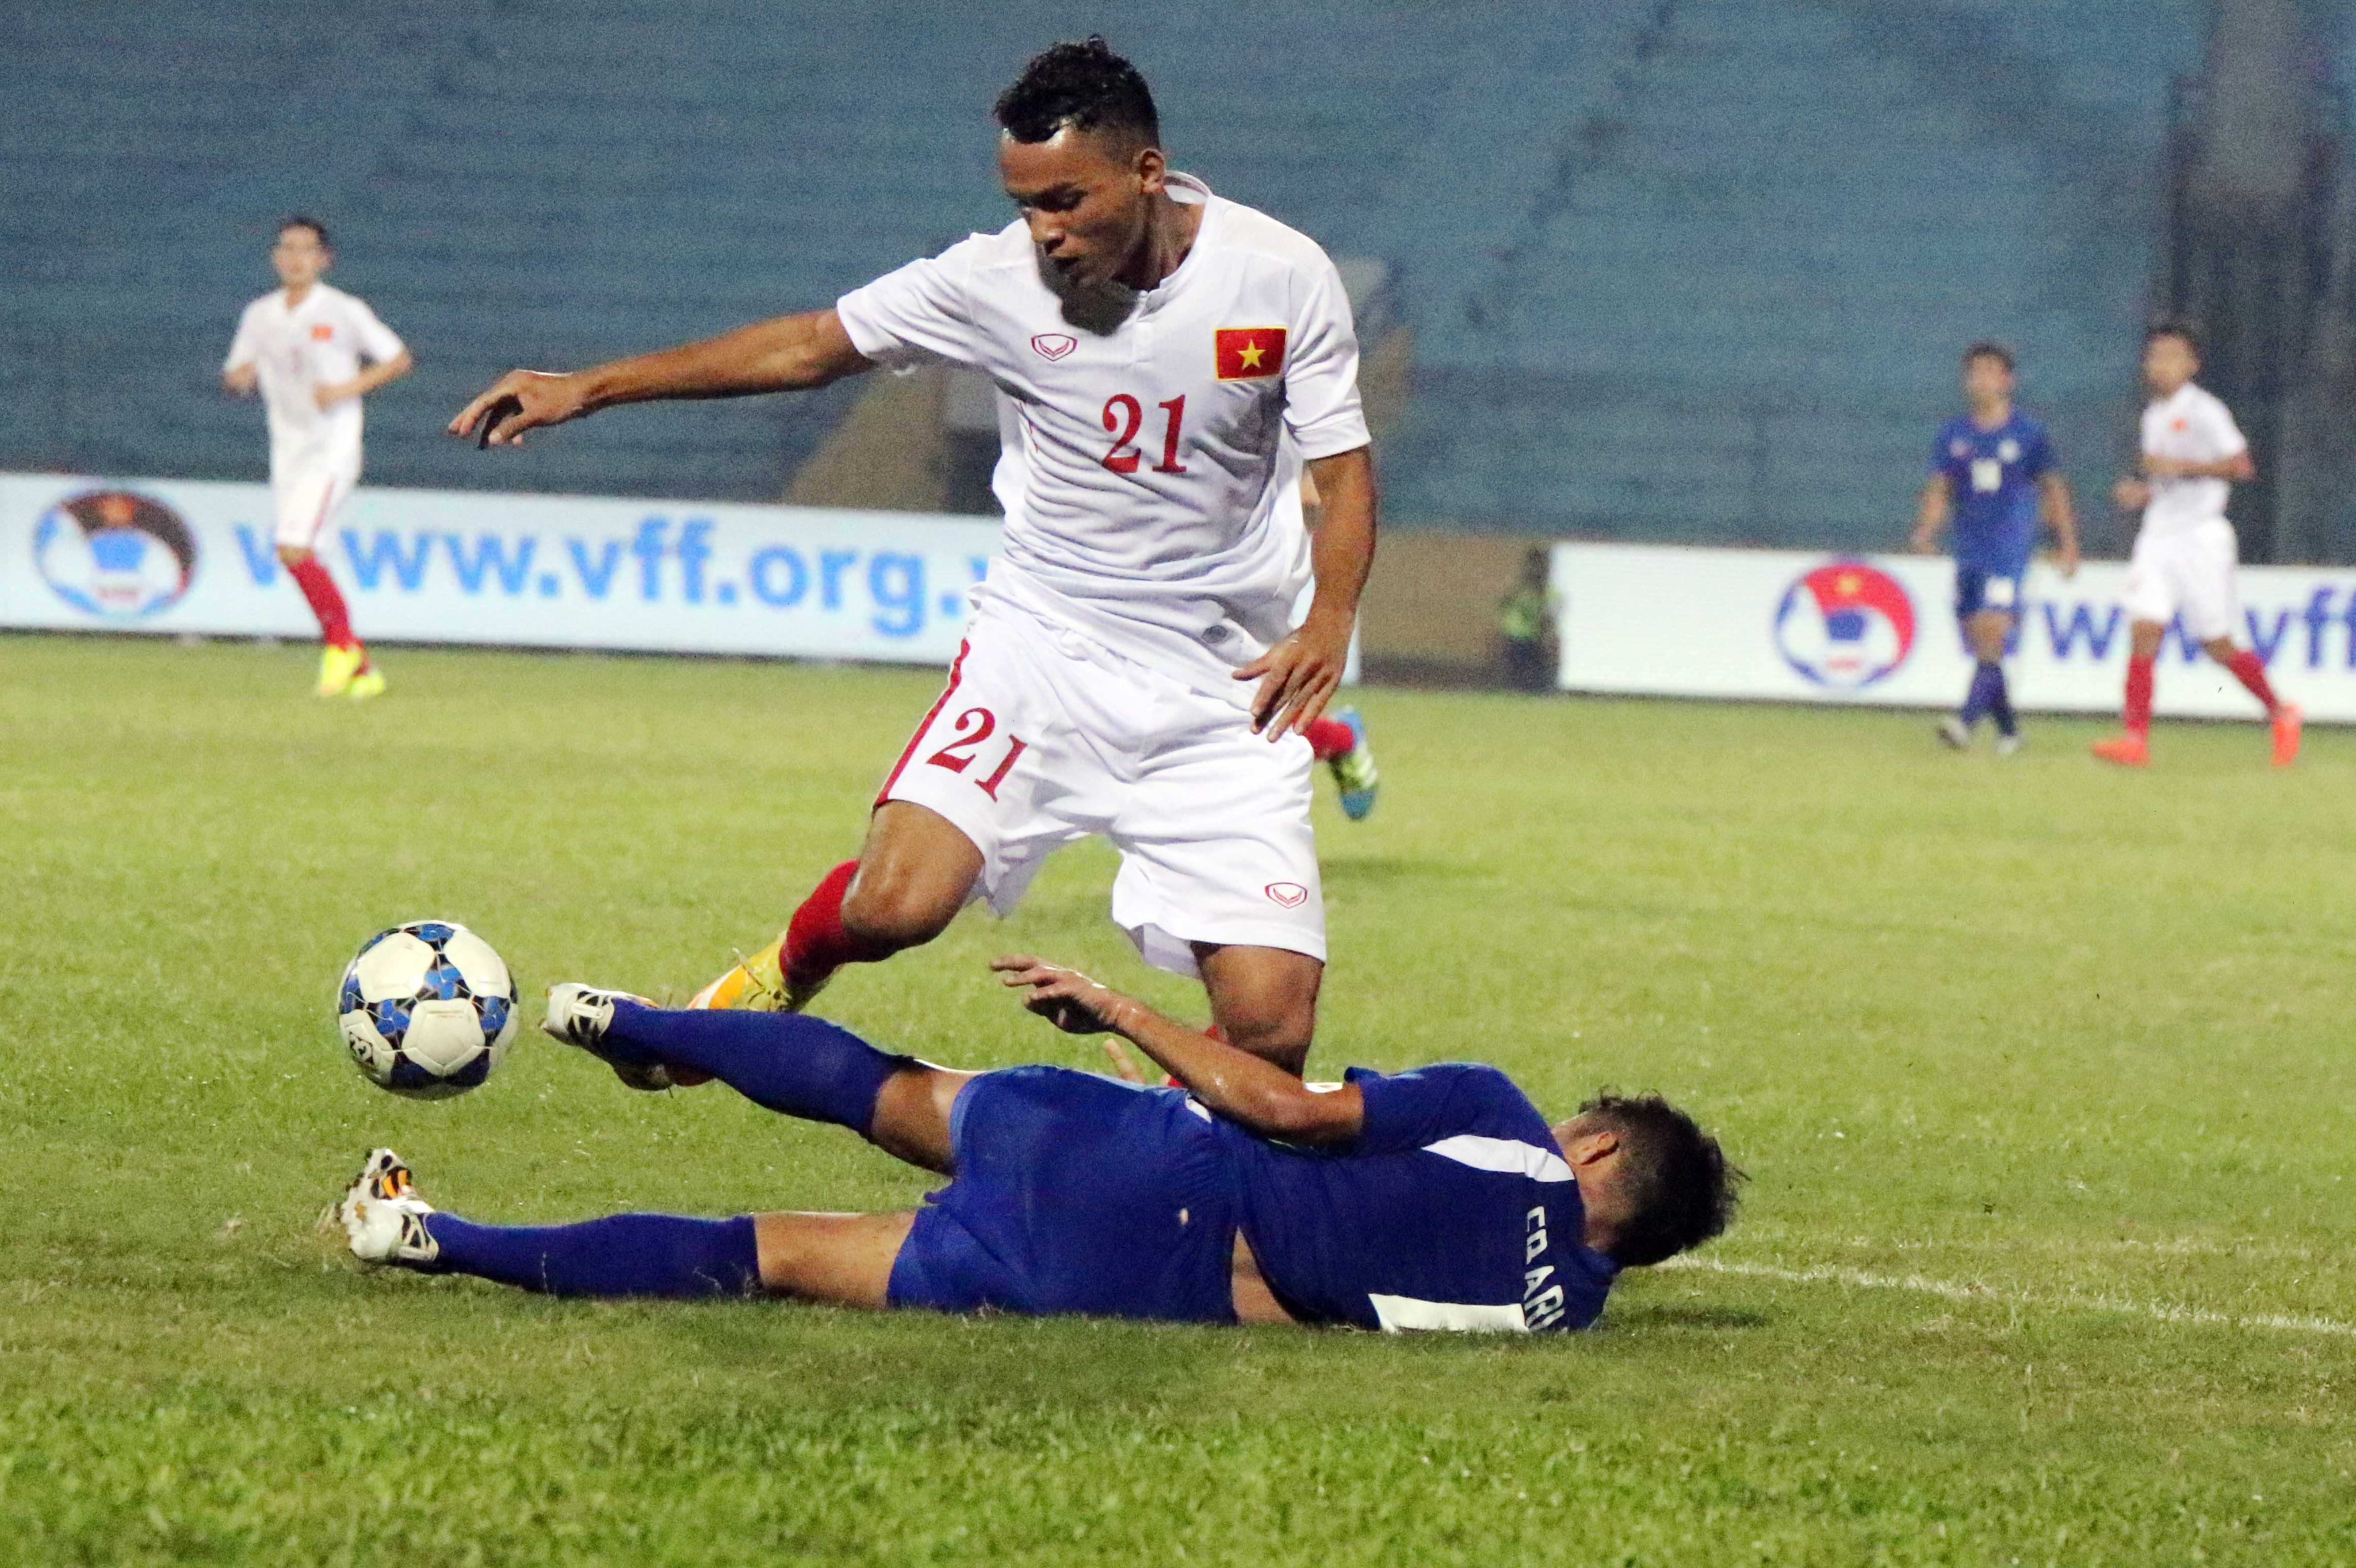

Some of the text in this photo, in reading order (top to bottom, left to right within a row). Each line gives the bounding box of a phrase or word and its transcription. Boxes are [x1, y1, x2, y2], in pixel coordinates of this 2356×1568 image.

[1101, 394, 1187, 473] 21
[233, 515, 989, 637] ww.vff.org.
[926, 707, 1028, 803] 21
